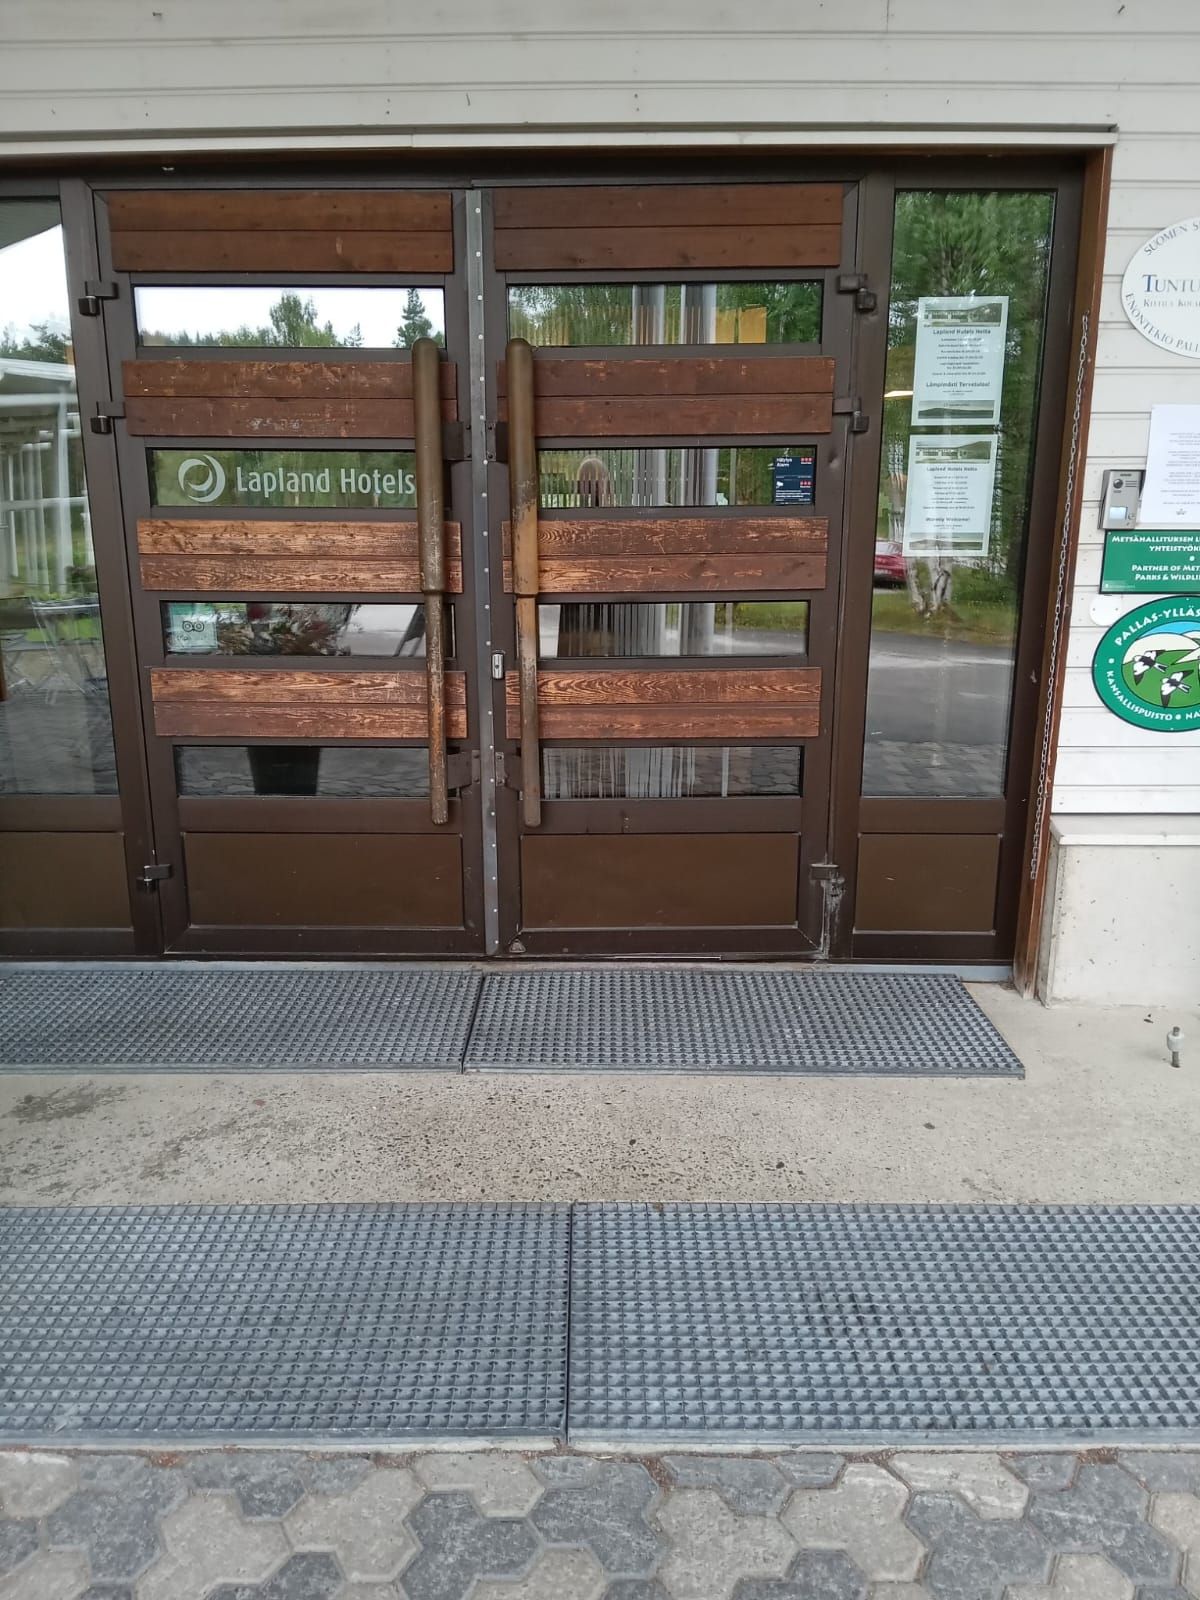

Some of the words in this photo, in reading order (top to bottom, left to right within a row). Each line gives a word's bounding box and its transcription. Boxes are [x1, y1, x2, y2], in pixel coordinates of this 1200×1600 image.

[1192, 219, 1200, 232] S
[236, 466, 330, 498] Lapland
[340, 468, 415, 494] Hotels
[1111, 535, 1193, 543] METSÄHALLITUKSEN
[1131, 564, 1169, 572] PARTNER
[1135, 573, 1161, 581] PARKS
[1114, 604, 1200, 646] PALLAS-YLLÄS
[1106, 670, 1173, 721] KANSALLISPUISTO
[1185, 709, 1200, 720] NA
